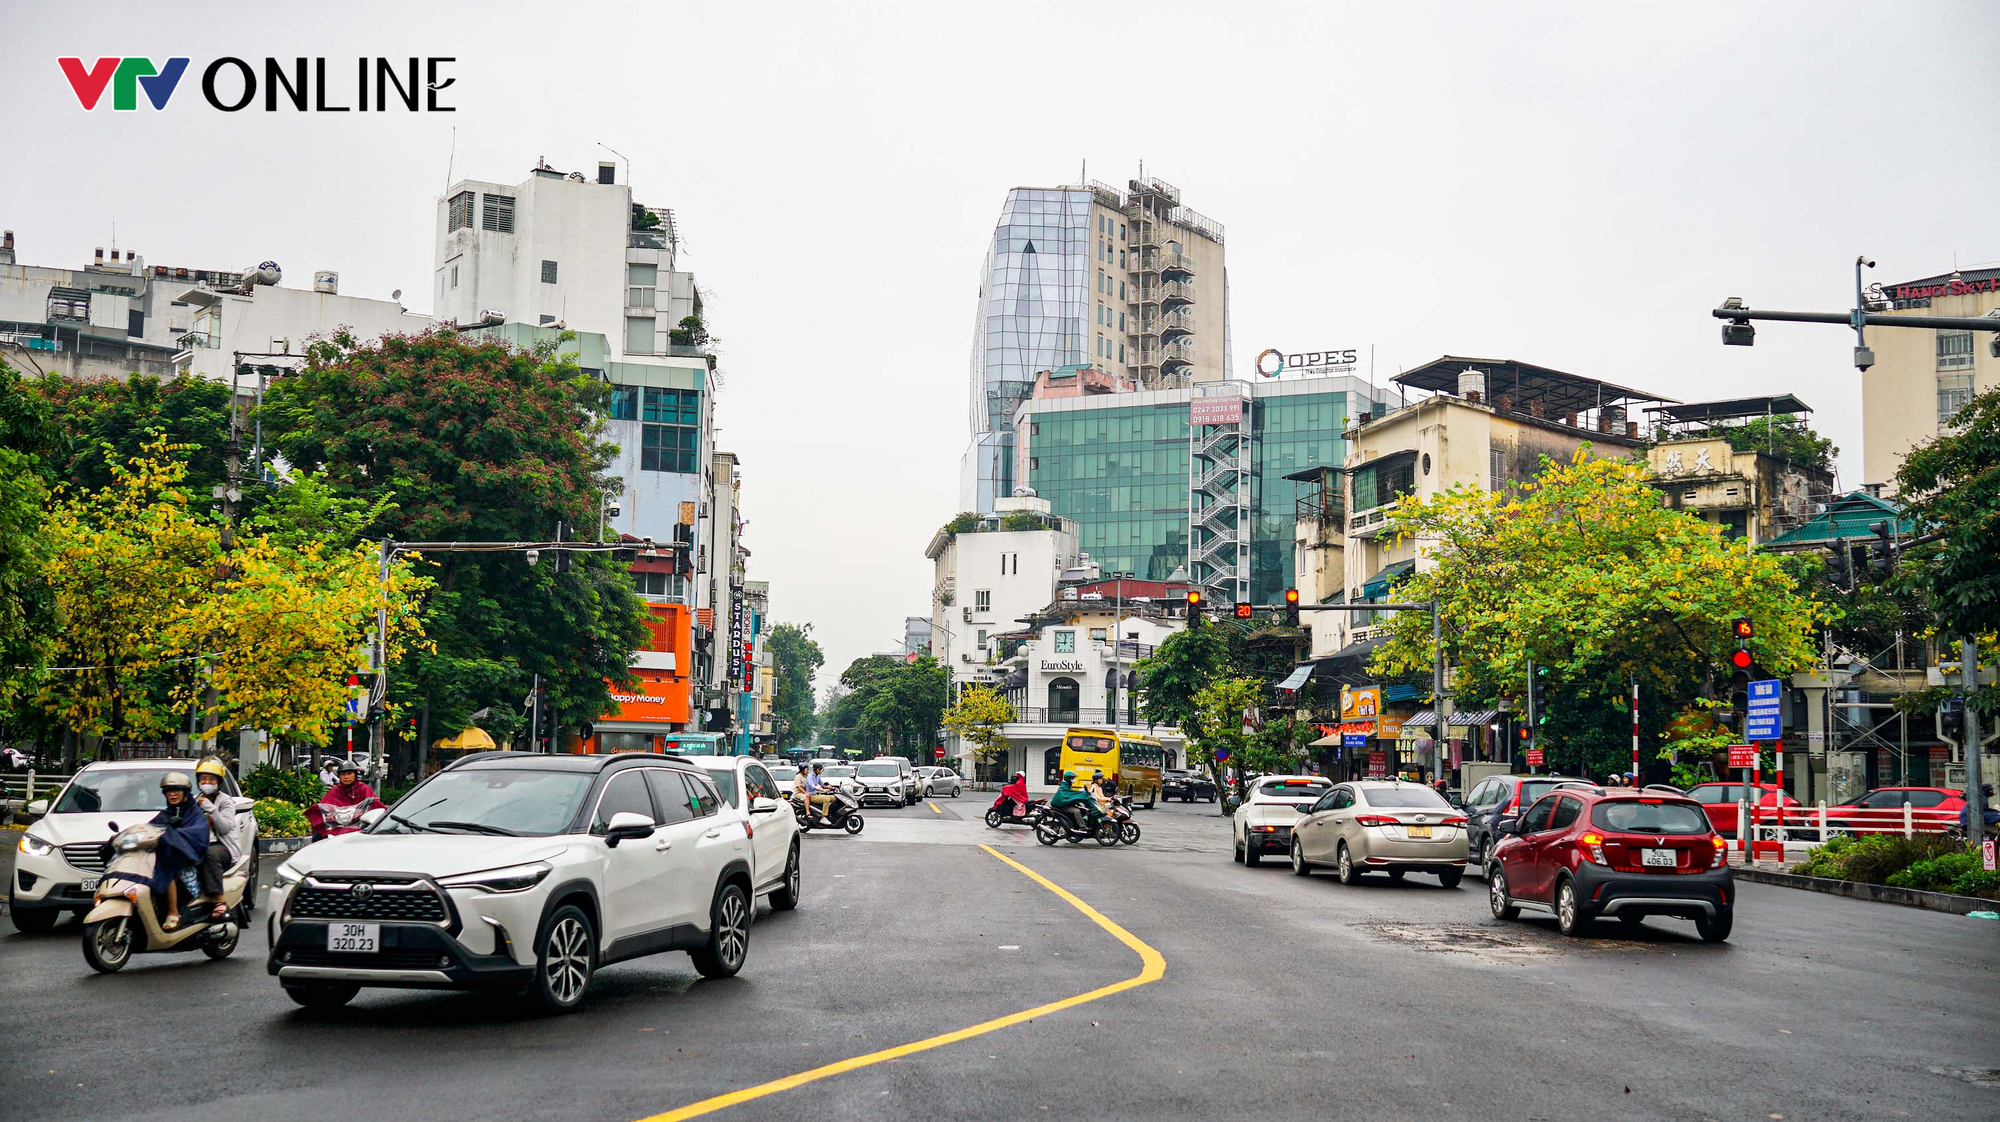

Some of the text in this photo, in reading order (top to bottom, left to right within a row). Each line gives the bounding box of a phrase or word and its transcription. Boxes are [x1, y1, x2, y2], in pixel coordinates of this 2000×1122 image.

[1896, 285, 1948, 298] HANOI
[1950, 280, 1986, 295] SKY
[1289, 349, 1357, 367] OPES
[1193, 413, 1240, 423] 0918 418 635
[1237, 605, 1251, 617] 20
[743, 610, 751, 635] SHOES
[732, 603, 741, 675] STARDUST
[1041, 660, 1083, 671] EuroStyle
[636, 694, 666, 704] Money
[343, 924, 366, 936] 30H
[333, 938, 374, 950] 320.23
